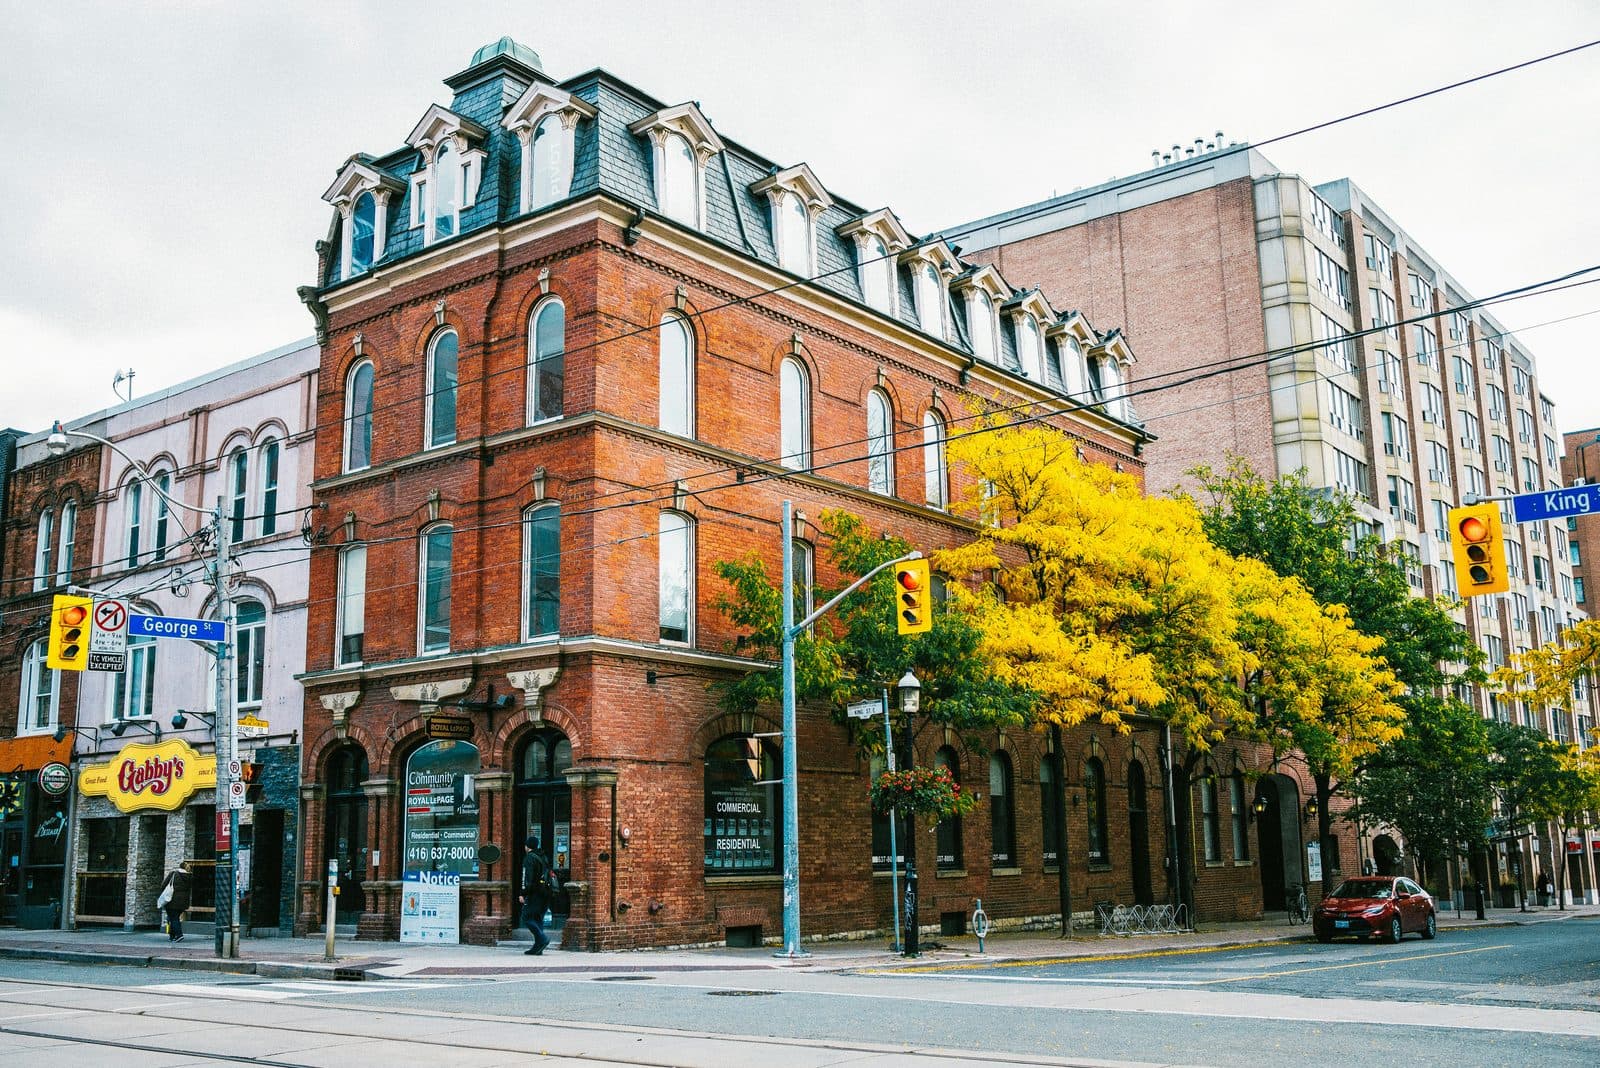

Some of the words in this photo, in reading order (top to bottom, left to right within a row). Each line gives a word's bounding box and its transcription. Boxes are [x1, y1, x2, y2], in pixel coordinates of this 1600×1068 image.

[1544, 492, 1590, 513] King
[143, 617, 198, 638] George
[203, 622, 212, 630] St
[118, 755, 185, 794] Gabby's
[408, 771, 455, 785] Community
[408, 796, 429, 805] ROYAL
[716, 802, 761, 813] COMMERCIAL
[411, 831, 439, 839] Residential
[443, 830, 476, 839] Commercial
[716, 838, 761, 850] RESIDENTIAL
[407, 847, 429, 862] (416)
[431, 846, 474, 860] 637-8000
[420, 870, 460, 887] Notice
